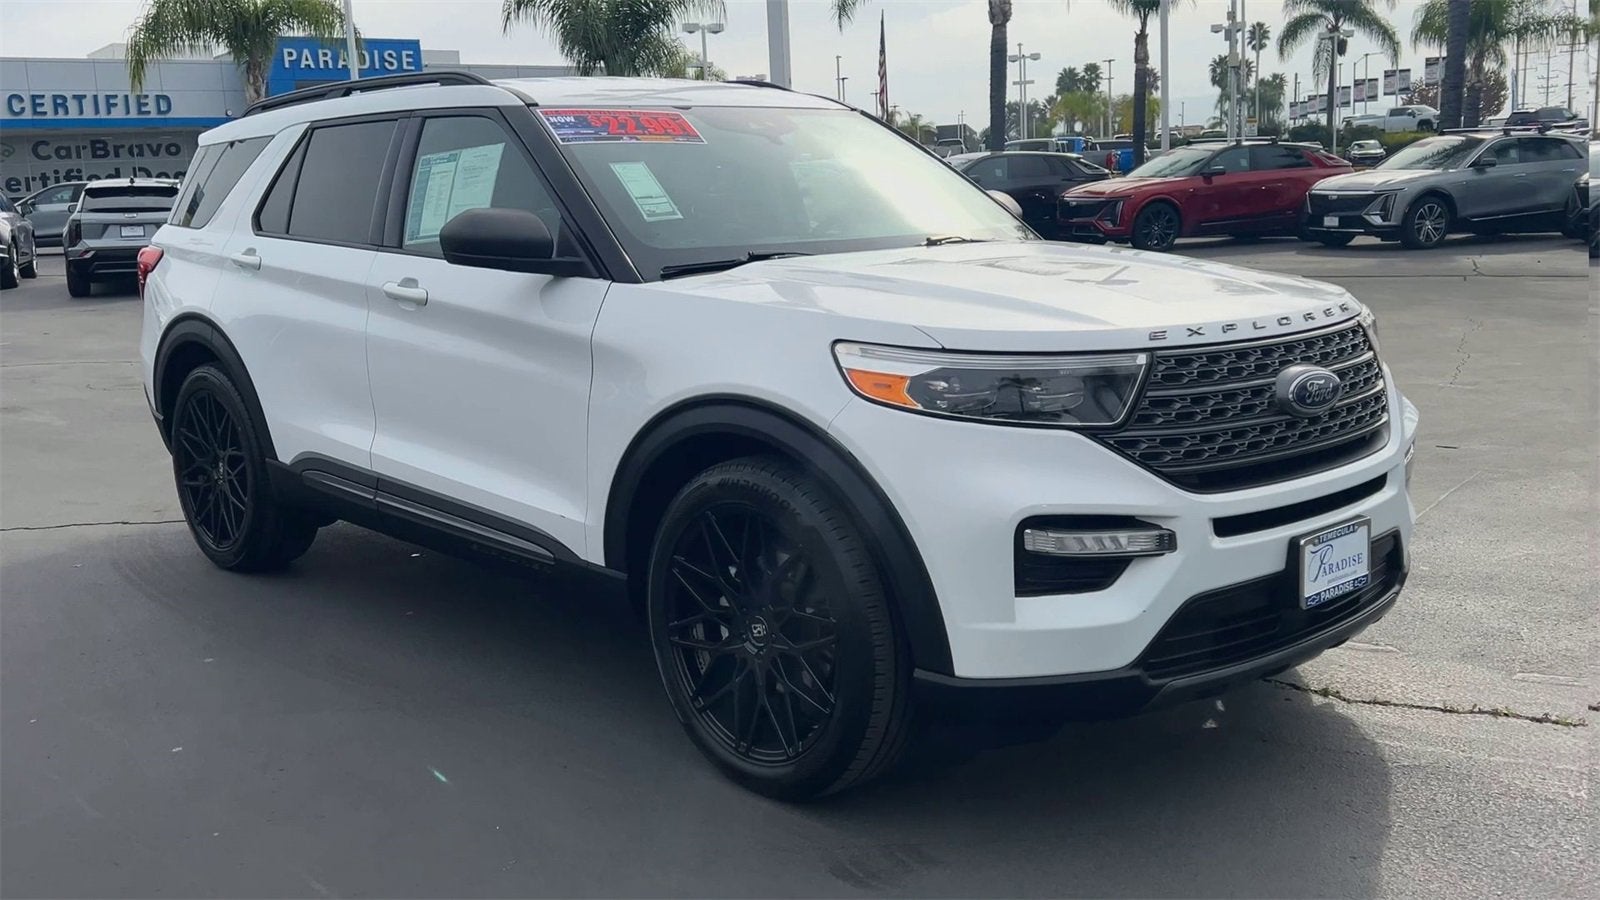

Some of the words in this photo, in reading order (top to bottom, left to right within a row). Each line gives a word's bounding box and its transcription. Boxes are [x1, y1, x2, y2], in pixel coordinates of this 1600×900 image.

[282, 48, 416, 71] PARADISE
[7, 93, 173, 117] CERTIFIED
[550, 115, 575, 123] NOW
[31, 139, 182, 161] CarBravo
[1148, 303, 1350, 341] EXPLORER
[1305, 379, 1333, 404] Ford
[1320, 524, 1355, 543] TEMECULA
[1320, 579, 1355, 602] PARADISE
